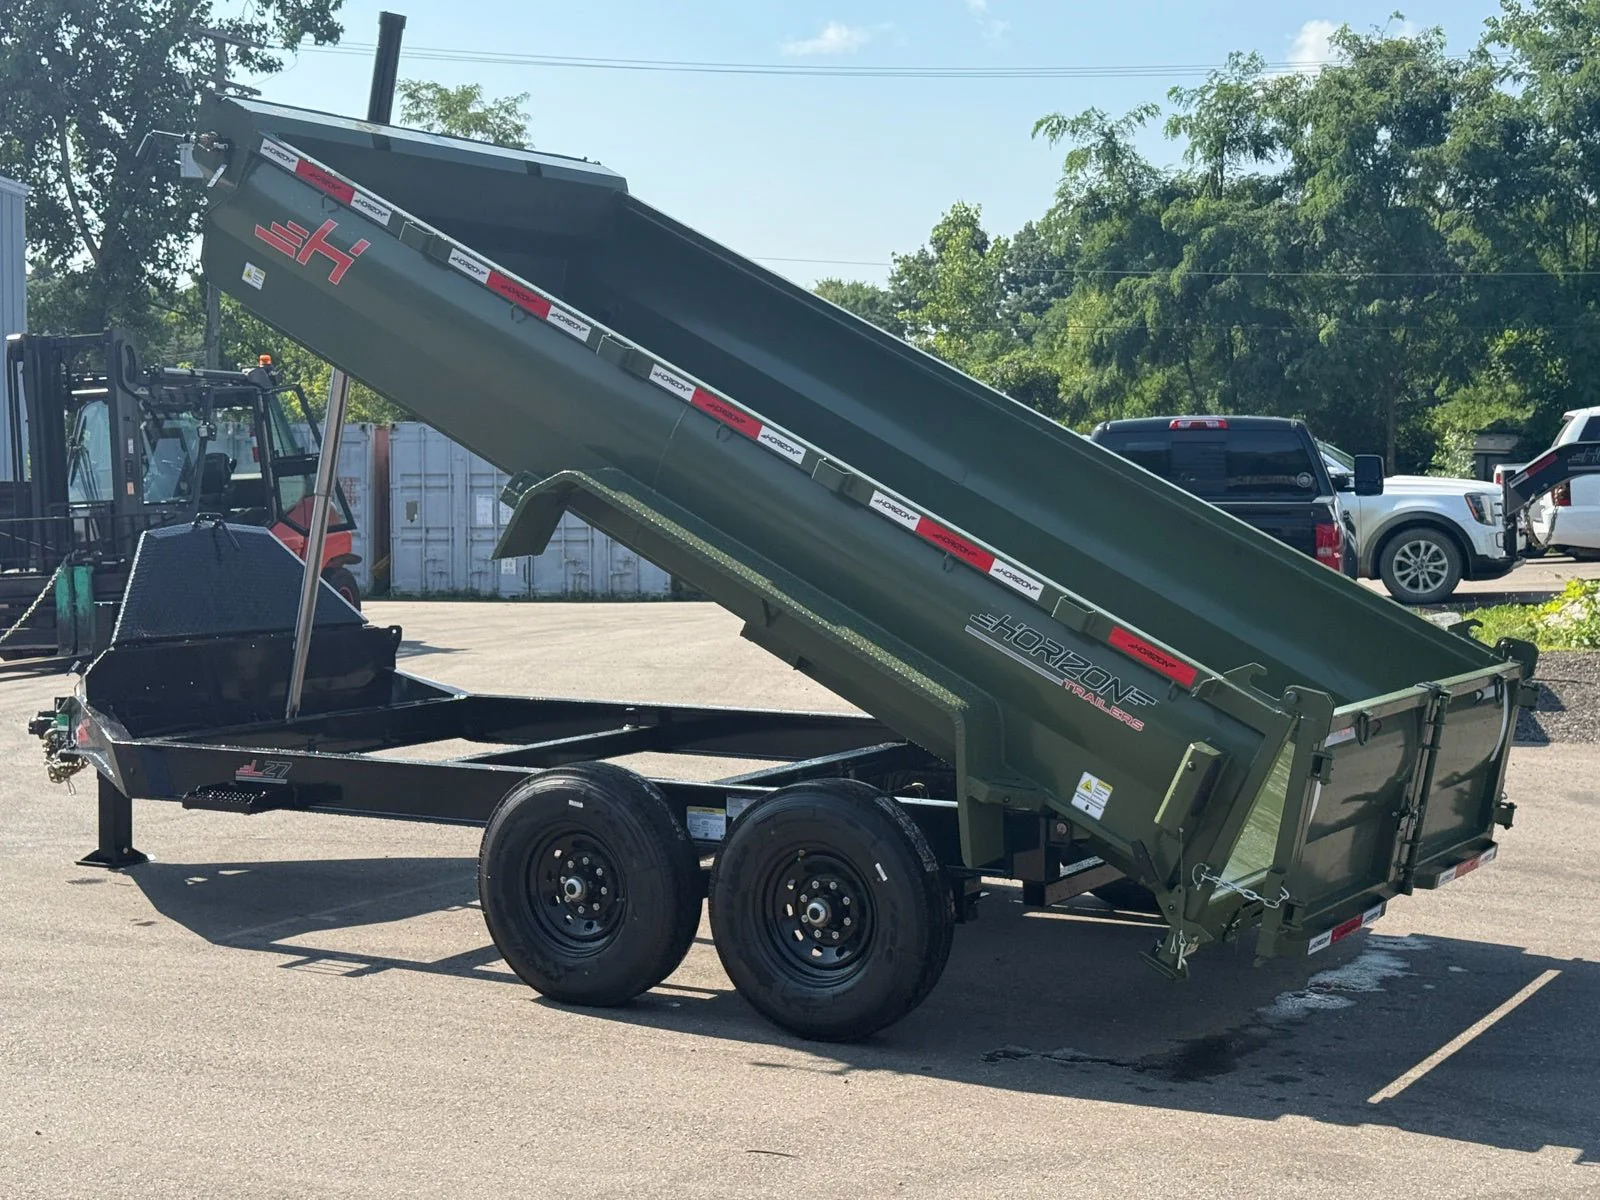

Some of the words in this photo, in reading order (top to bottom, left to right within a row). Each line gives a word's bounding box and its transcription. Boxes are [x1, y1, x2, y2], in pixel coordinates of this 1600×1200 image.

[354, 198, 389, 218] HORIZON
[451, 256, 487, 276] HORIZON
[550, 312, 588, 333] HORIZON
[653, 370, 693, 393] HORIZON
[761, 433, 803, 456] HORIZON
[873, 498, 918, 521] HORIZON
[933, 533, 978, 558] HORIZON
[993, 568, 1040, 592] HORIZON
[970, 614, 1159, 705] HORIZON
[1128, 643, 1177, 669] HORIZON
[1062, 678, 1145, 732] TRAILERS
